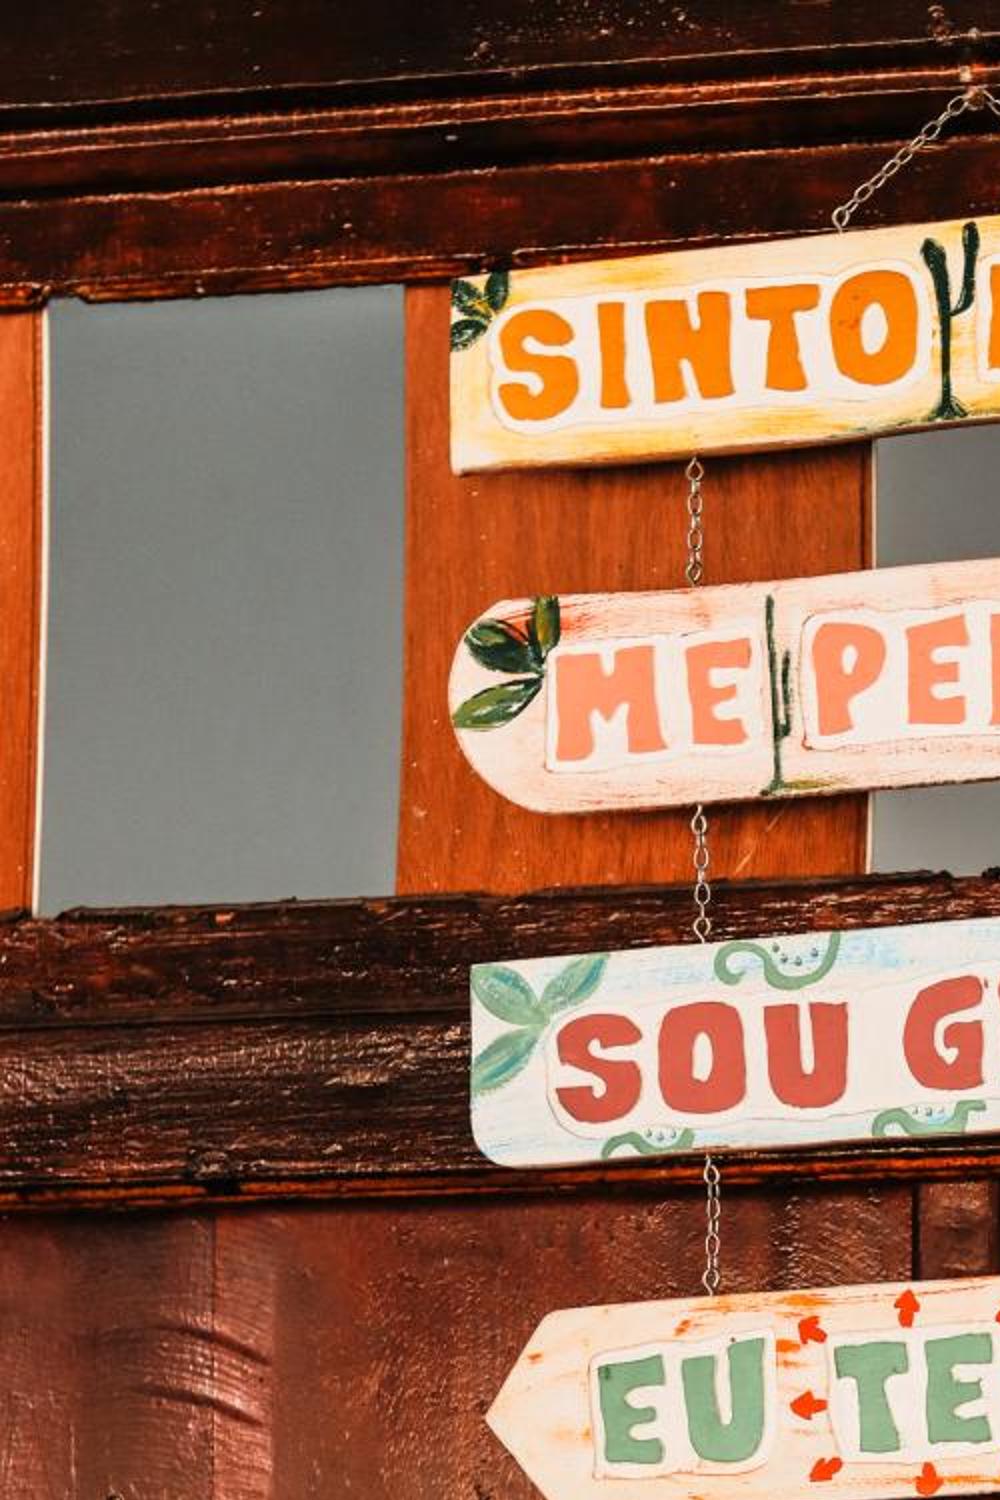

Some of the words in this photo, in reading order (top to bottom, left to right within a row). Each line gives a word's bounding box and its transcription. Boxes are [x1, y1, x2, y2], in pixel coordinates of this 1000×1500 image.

[496, 268, 920, 421] SINTO
[555, 638, 752, 762] ME
[554, 1001, 848, 1124] SOU
[597, 1337, 768, 1465] EU
[831, 1332, 992, 1454] TE
